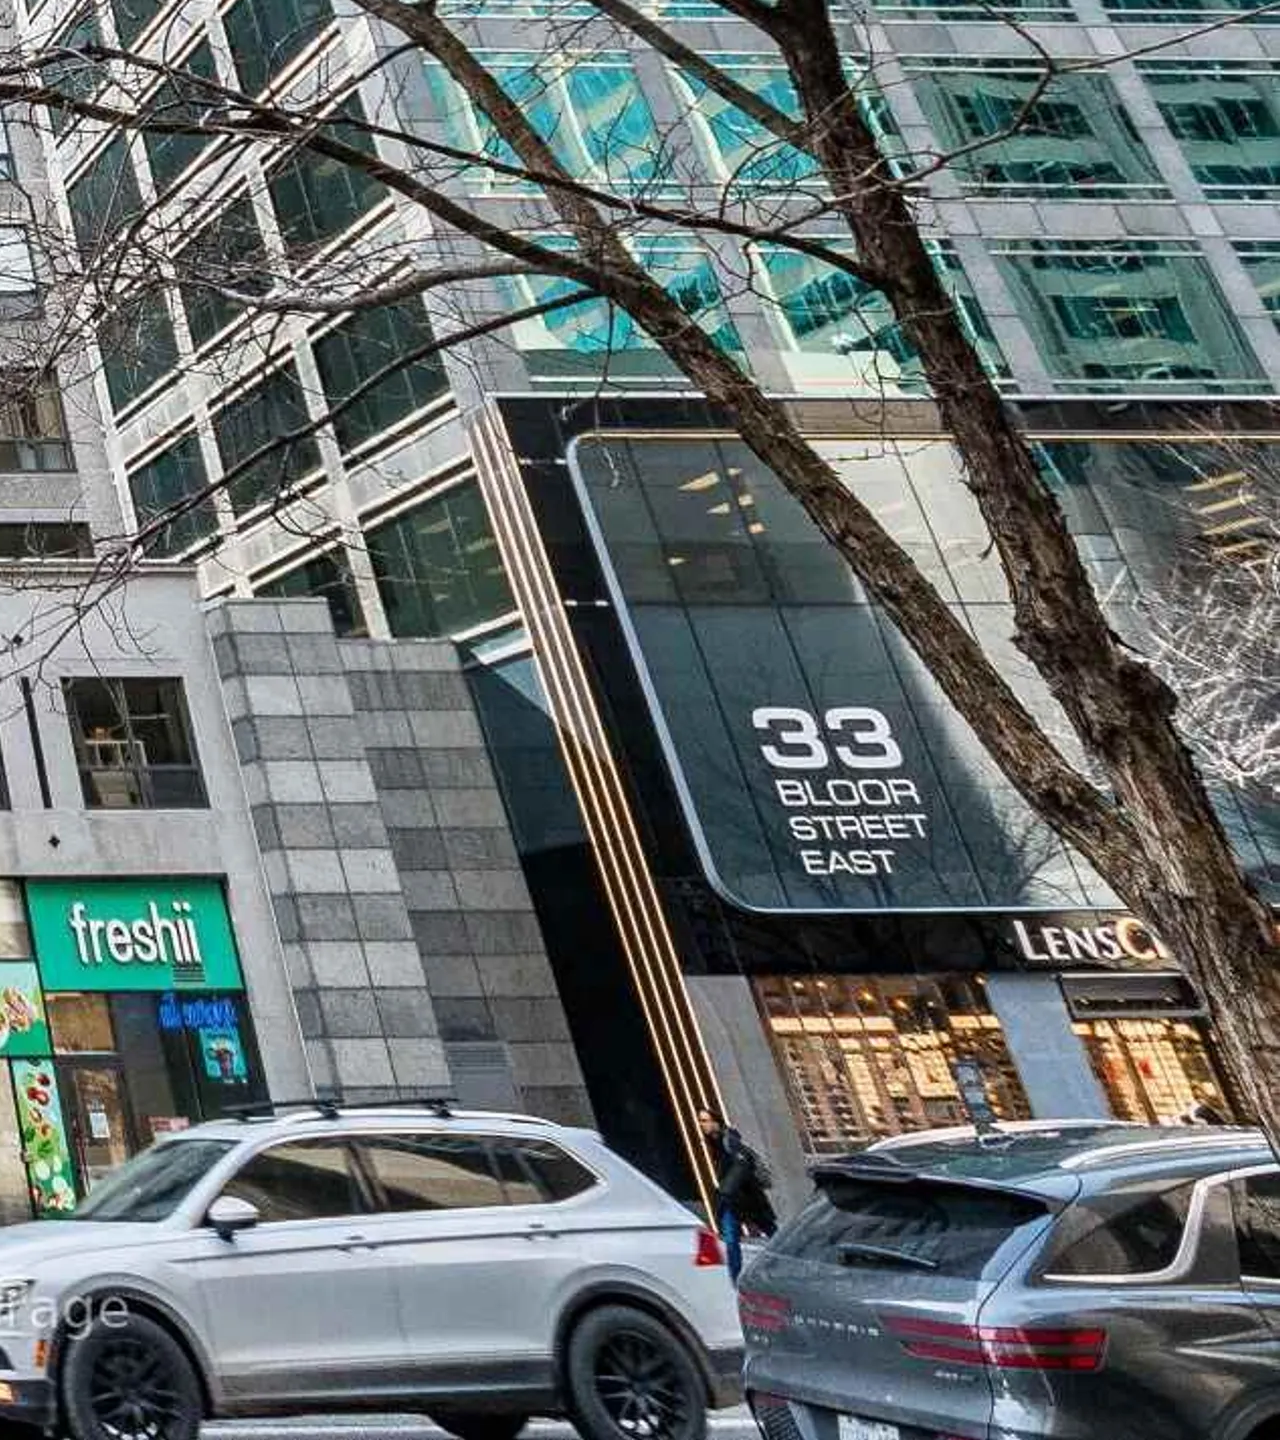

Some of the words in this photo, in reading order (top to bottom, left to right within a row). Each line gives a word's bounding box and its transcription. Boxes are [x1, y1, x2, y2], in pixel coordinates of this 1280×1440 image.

[752, 707, 904, 769] 33
[775, 778, 922, 807] BLOOR
[789, 813, 929, 841] STREET
[801, 849, 896, 875] EAST
[70, 900, 204, 964] freshii
